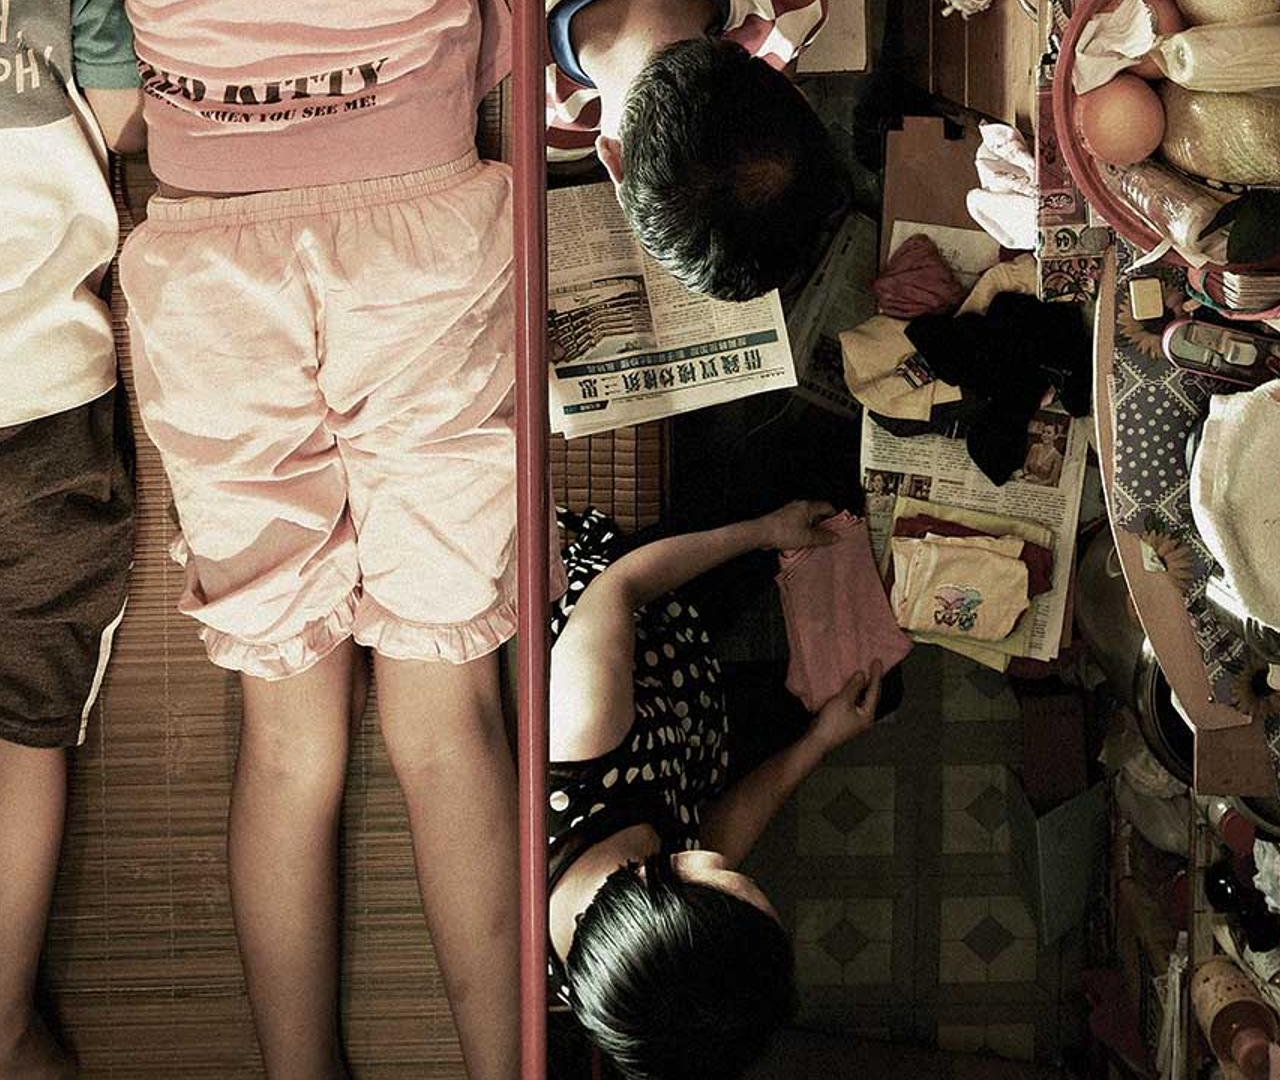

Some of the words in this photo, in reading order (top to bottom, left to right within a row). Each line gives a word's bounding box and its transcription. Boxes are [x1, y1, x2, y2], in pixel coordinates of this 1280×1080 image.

[223, 57, 389, 106] KITTY
[260, 108, 297, 123] YOU
[302, 104, 338, 119] SEE
[343, 94, 377, 113] ME!
[578, 349, 763, 399] 借錢買樓炒樓須三思
